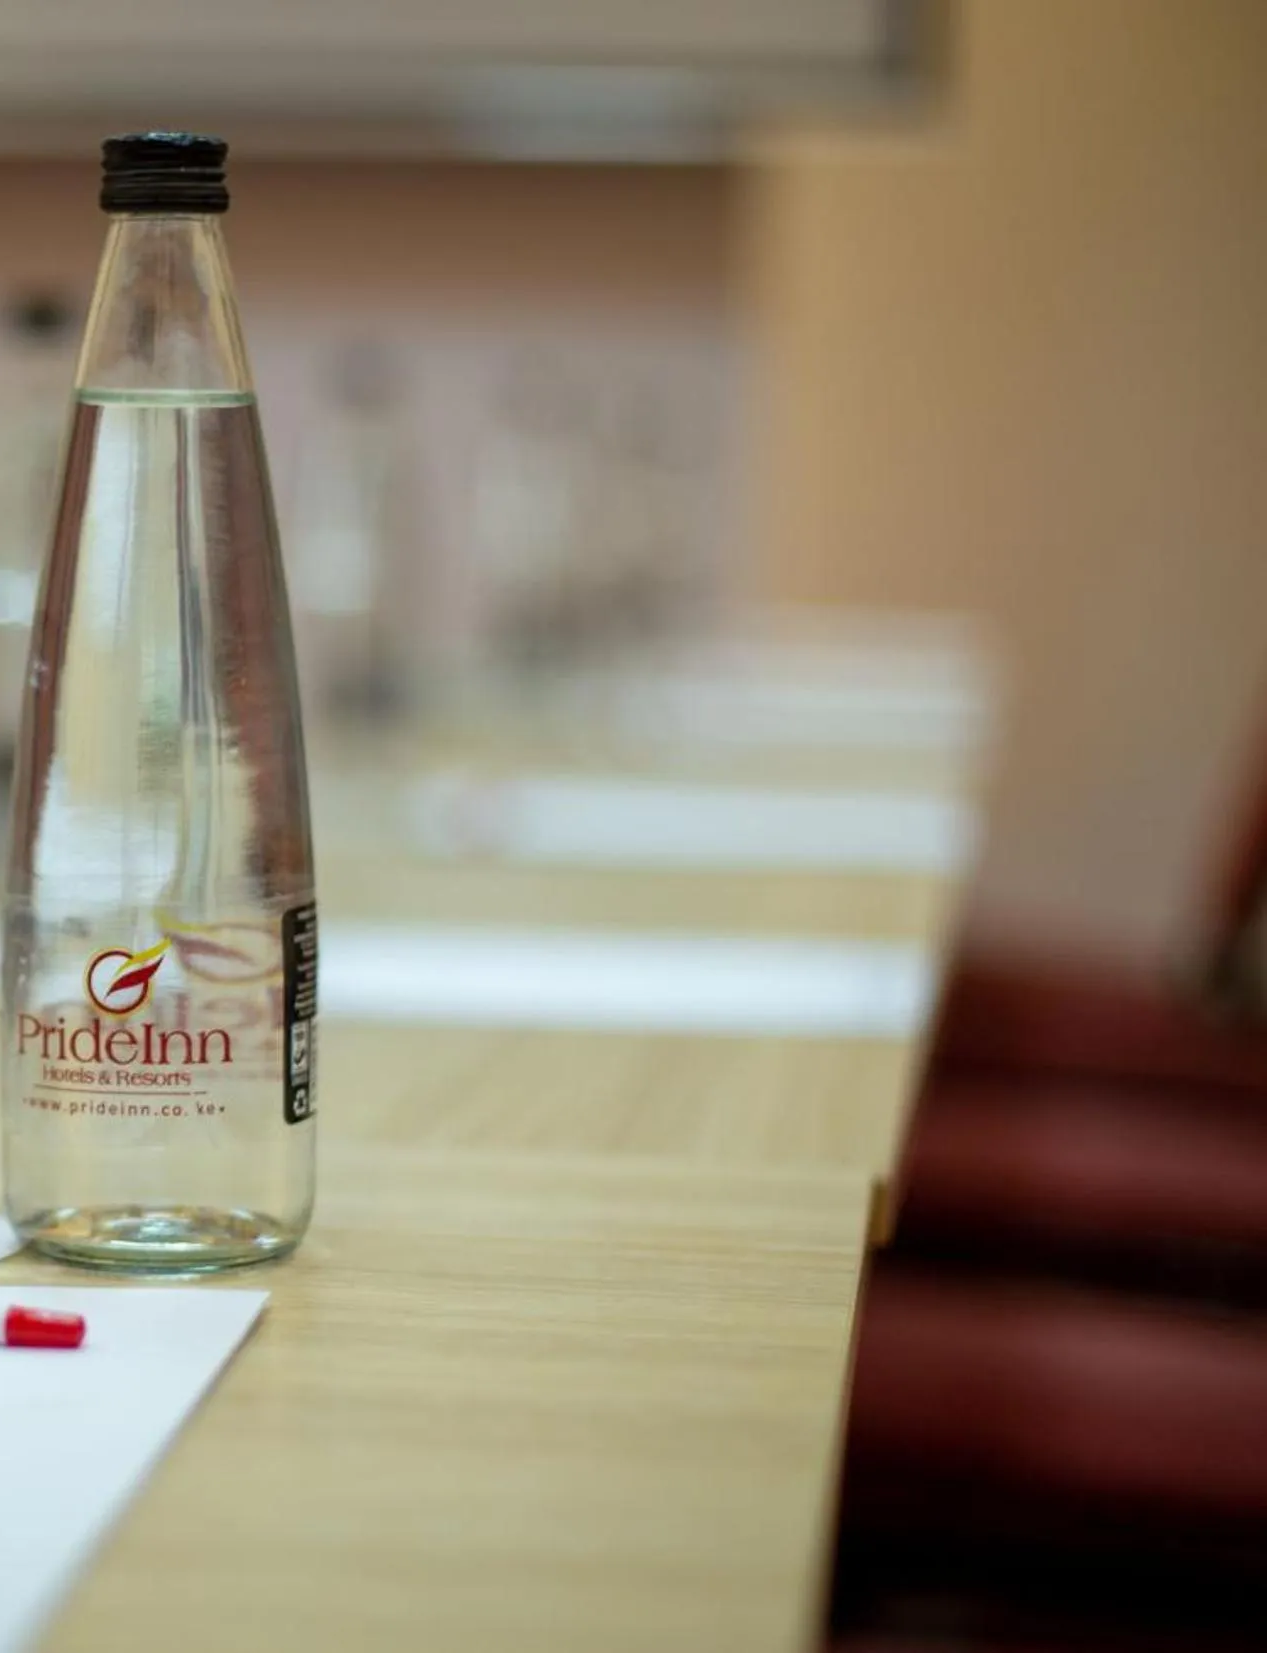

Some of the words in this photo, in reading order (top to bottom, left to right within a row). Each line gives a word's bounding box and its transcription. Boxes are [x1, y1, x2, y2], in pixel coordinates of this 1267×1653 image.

[18, 1013, 233, 1065] PrideInn
[42, 1064, 96, 1085] Hotels
[98, 1071, 111, 1086] &
[115, 1069, 193, 1088] Resorts
